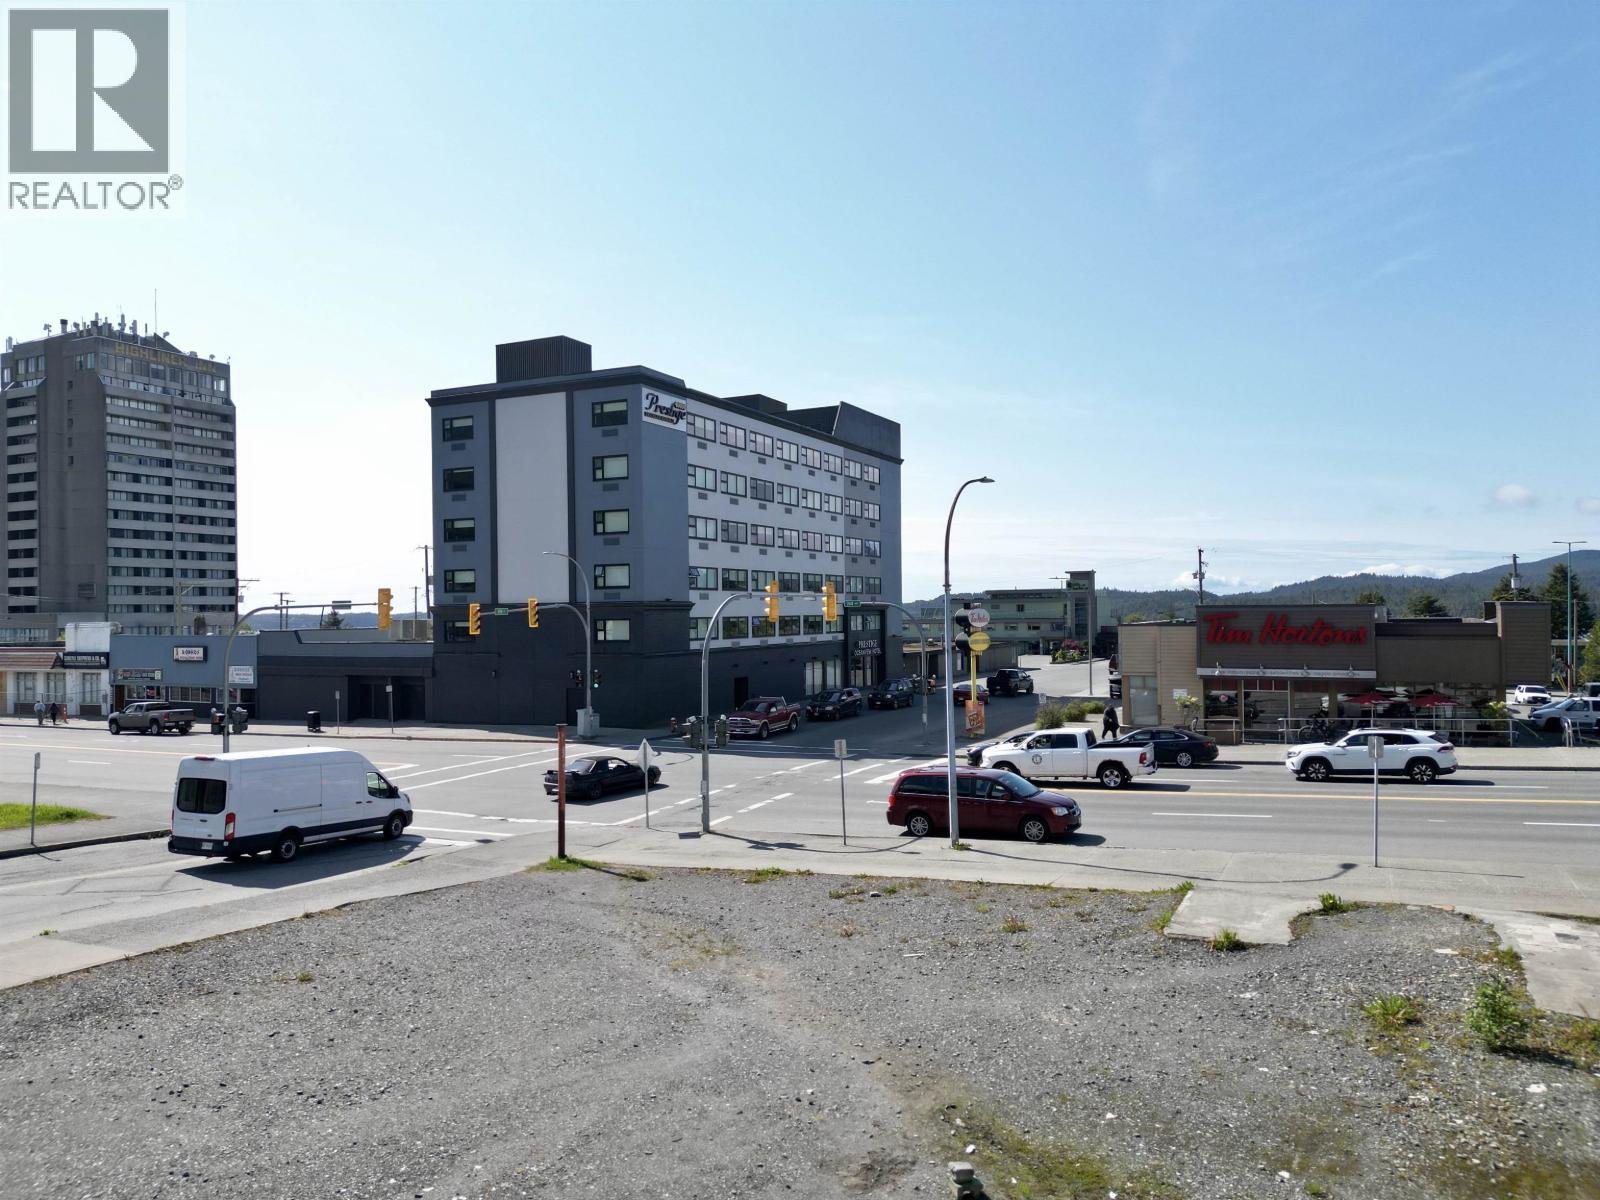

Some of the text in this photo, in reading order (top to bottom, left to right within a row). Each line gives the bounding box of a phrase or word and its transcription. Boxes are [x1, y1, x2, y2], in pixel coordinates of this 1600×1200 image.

[645, 392, 687, 424] Prestige
[858, 639, 878, 648] PRESTIGE
[1202, 611, 1368, 646] Tim Hortons
